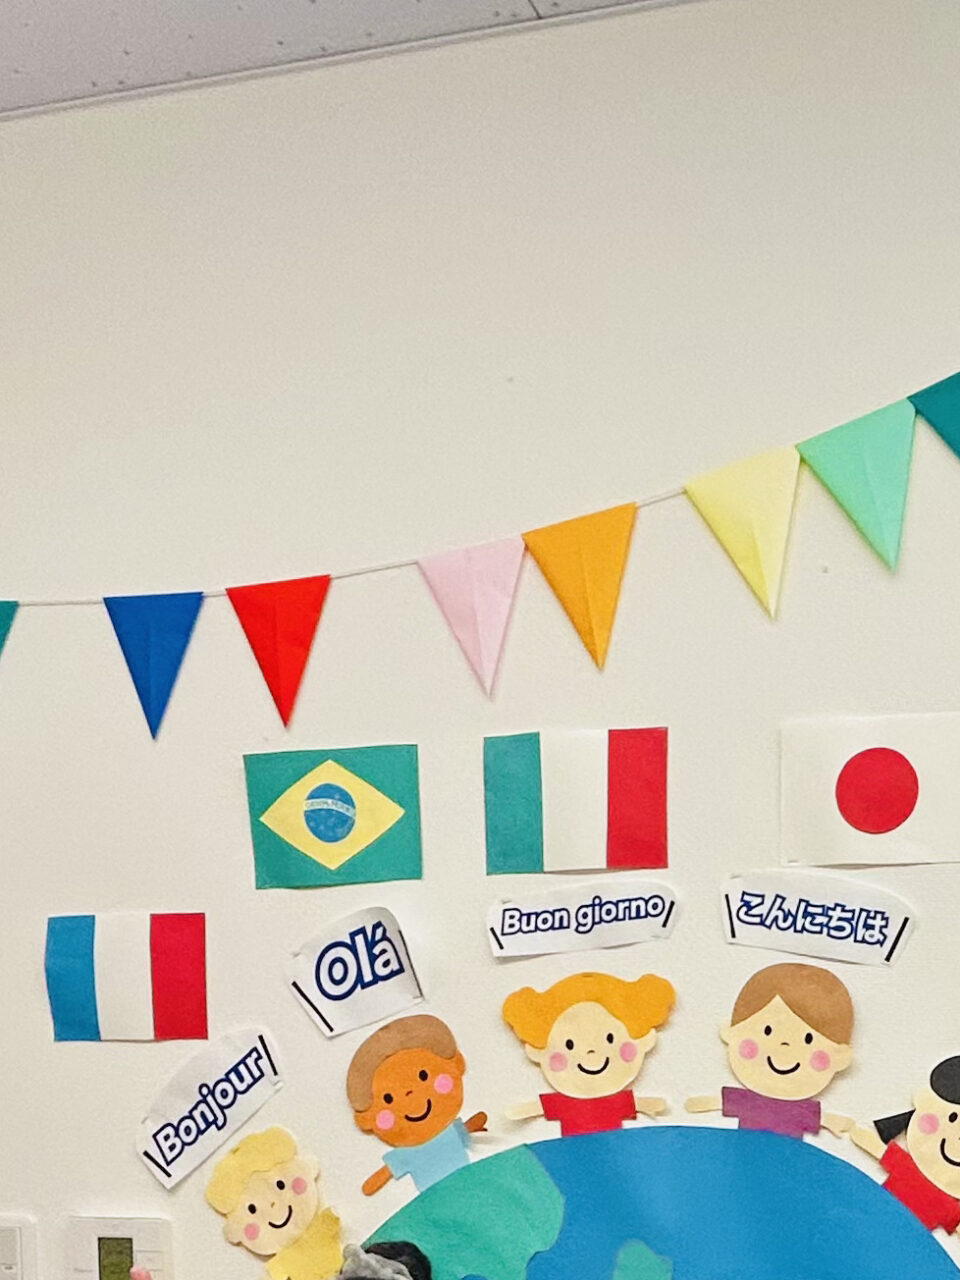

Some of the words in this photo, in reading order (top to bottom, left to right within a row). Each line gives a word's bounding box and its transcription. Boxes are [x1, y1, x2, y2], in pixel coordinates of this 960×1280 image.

[501, 908, 570, 936] Buon
[575, 895, 665, 934] giorno
[736, 891, 890, 947] こんにちは
[314, 921, 404, 1000] Olá
[153, 1047, 266, 1166] Bonjour
